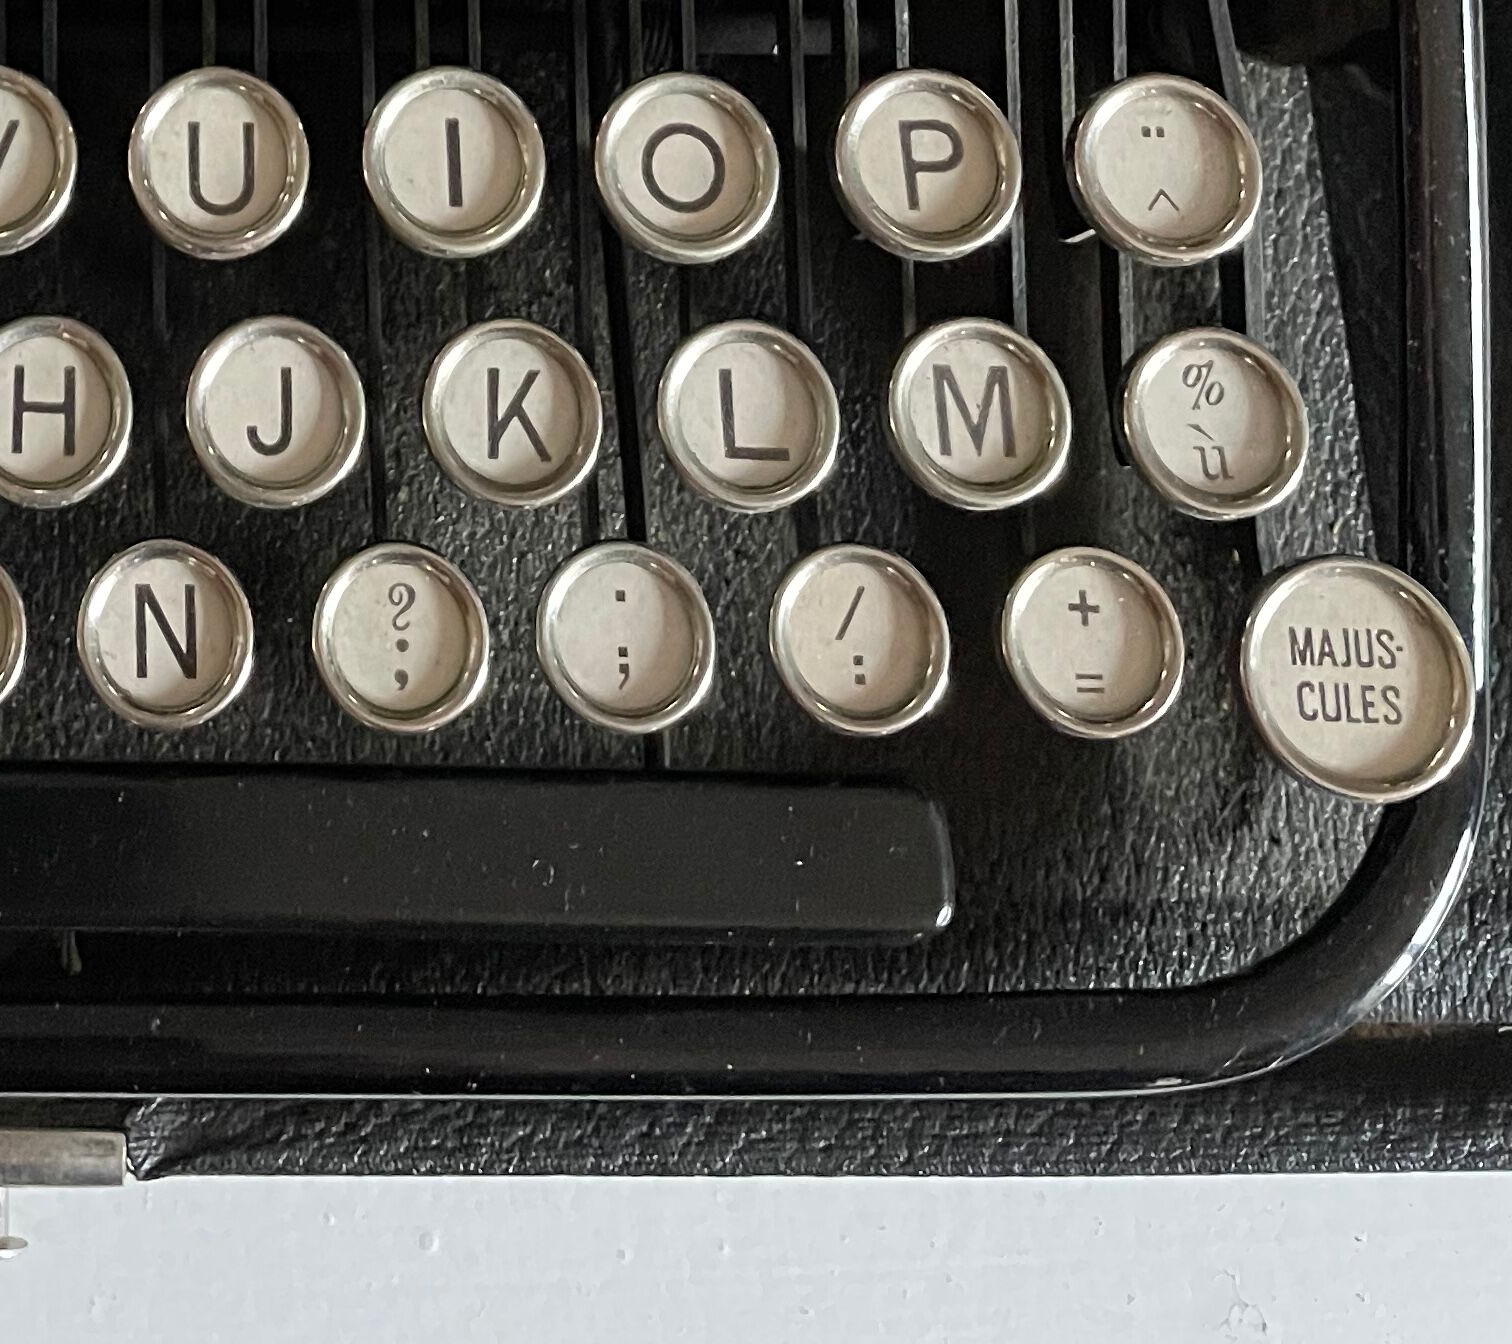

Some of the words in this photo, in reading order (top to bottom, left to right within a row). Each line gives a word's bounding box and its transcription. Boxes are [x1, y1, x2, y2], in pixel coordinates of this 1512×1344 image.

[188, 122, 255, 216] U
[446, 118, 463, 207] I
[642, 123, 725, 213] O
[899, 120, 964, 211] P
[12, 365, 75, 456] H
[247, 367, 292, 456] J
[488, 368, 552, 462] K
[719, 369, 790, 461] L
[933, 364, 1017, 458] M
[1182, 360, 1224, 410] %
[1187, 422, 1235, 480] ù
[136, 584, 197, 679] N
[388, 583, 415, 652] ?
[836, 586, 864, 640] /
[1068, 590, 1100, 626] +
[1287, 623, 1404, 670] MAJUS-
[1076, 674, 1105, 694] =
[1295, 681, 1404, 727] CULES
